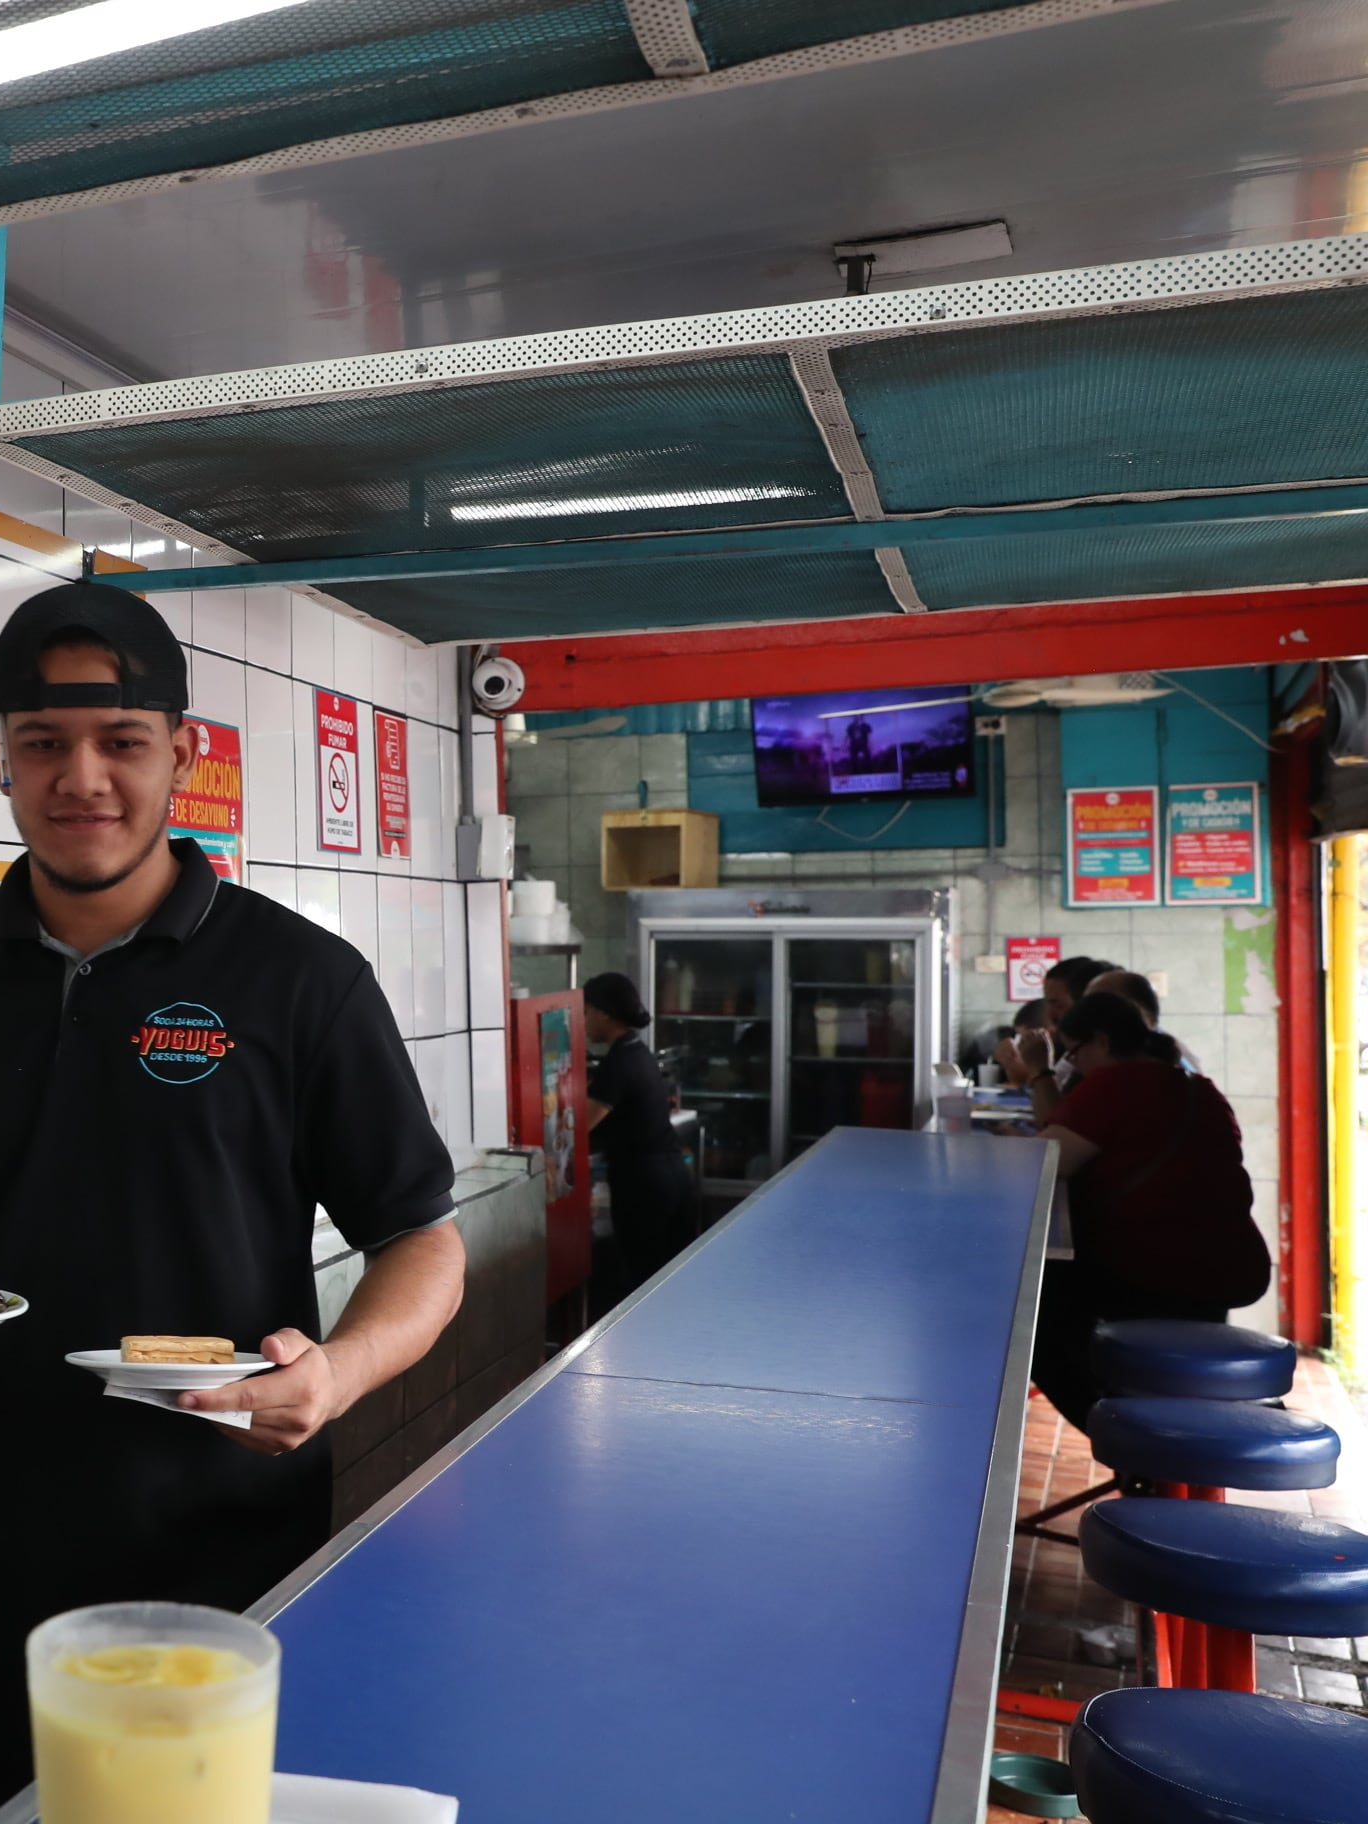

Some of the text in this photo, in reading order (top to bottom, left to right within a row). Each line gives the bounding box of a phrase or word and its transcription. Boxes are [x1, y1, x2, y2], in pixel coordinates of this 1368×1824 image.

[320, 713, 354, 737] PROHIBIDO
[327, 732, 347, 750] FUMAR
[186, 757, 241, 801] MOCIÓN
[175, 797, 229, 828] DE DESAYUNO
[139, 1026, 228, 1057] YOGUIS
[149, 1052, 184, 1062] DESDE
